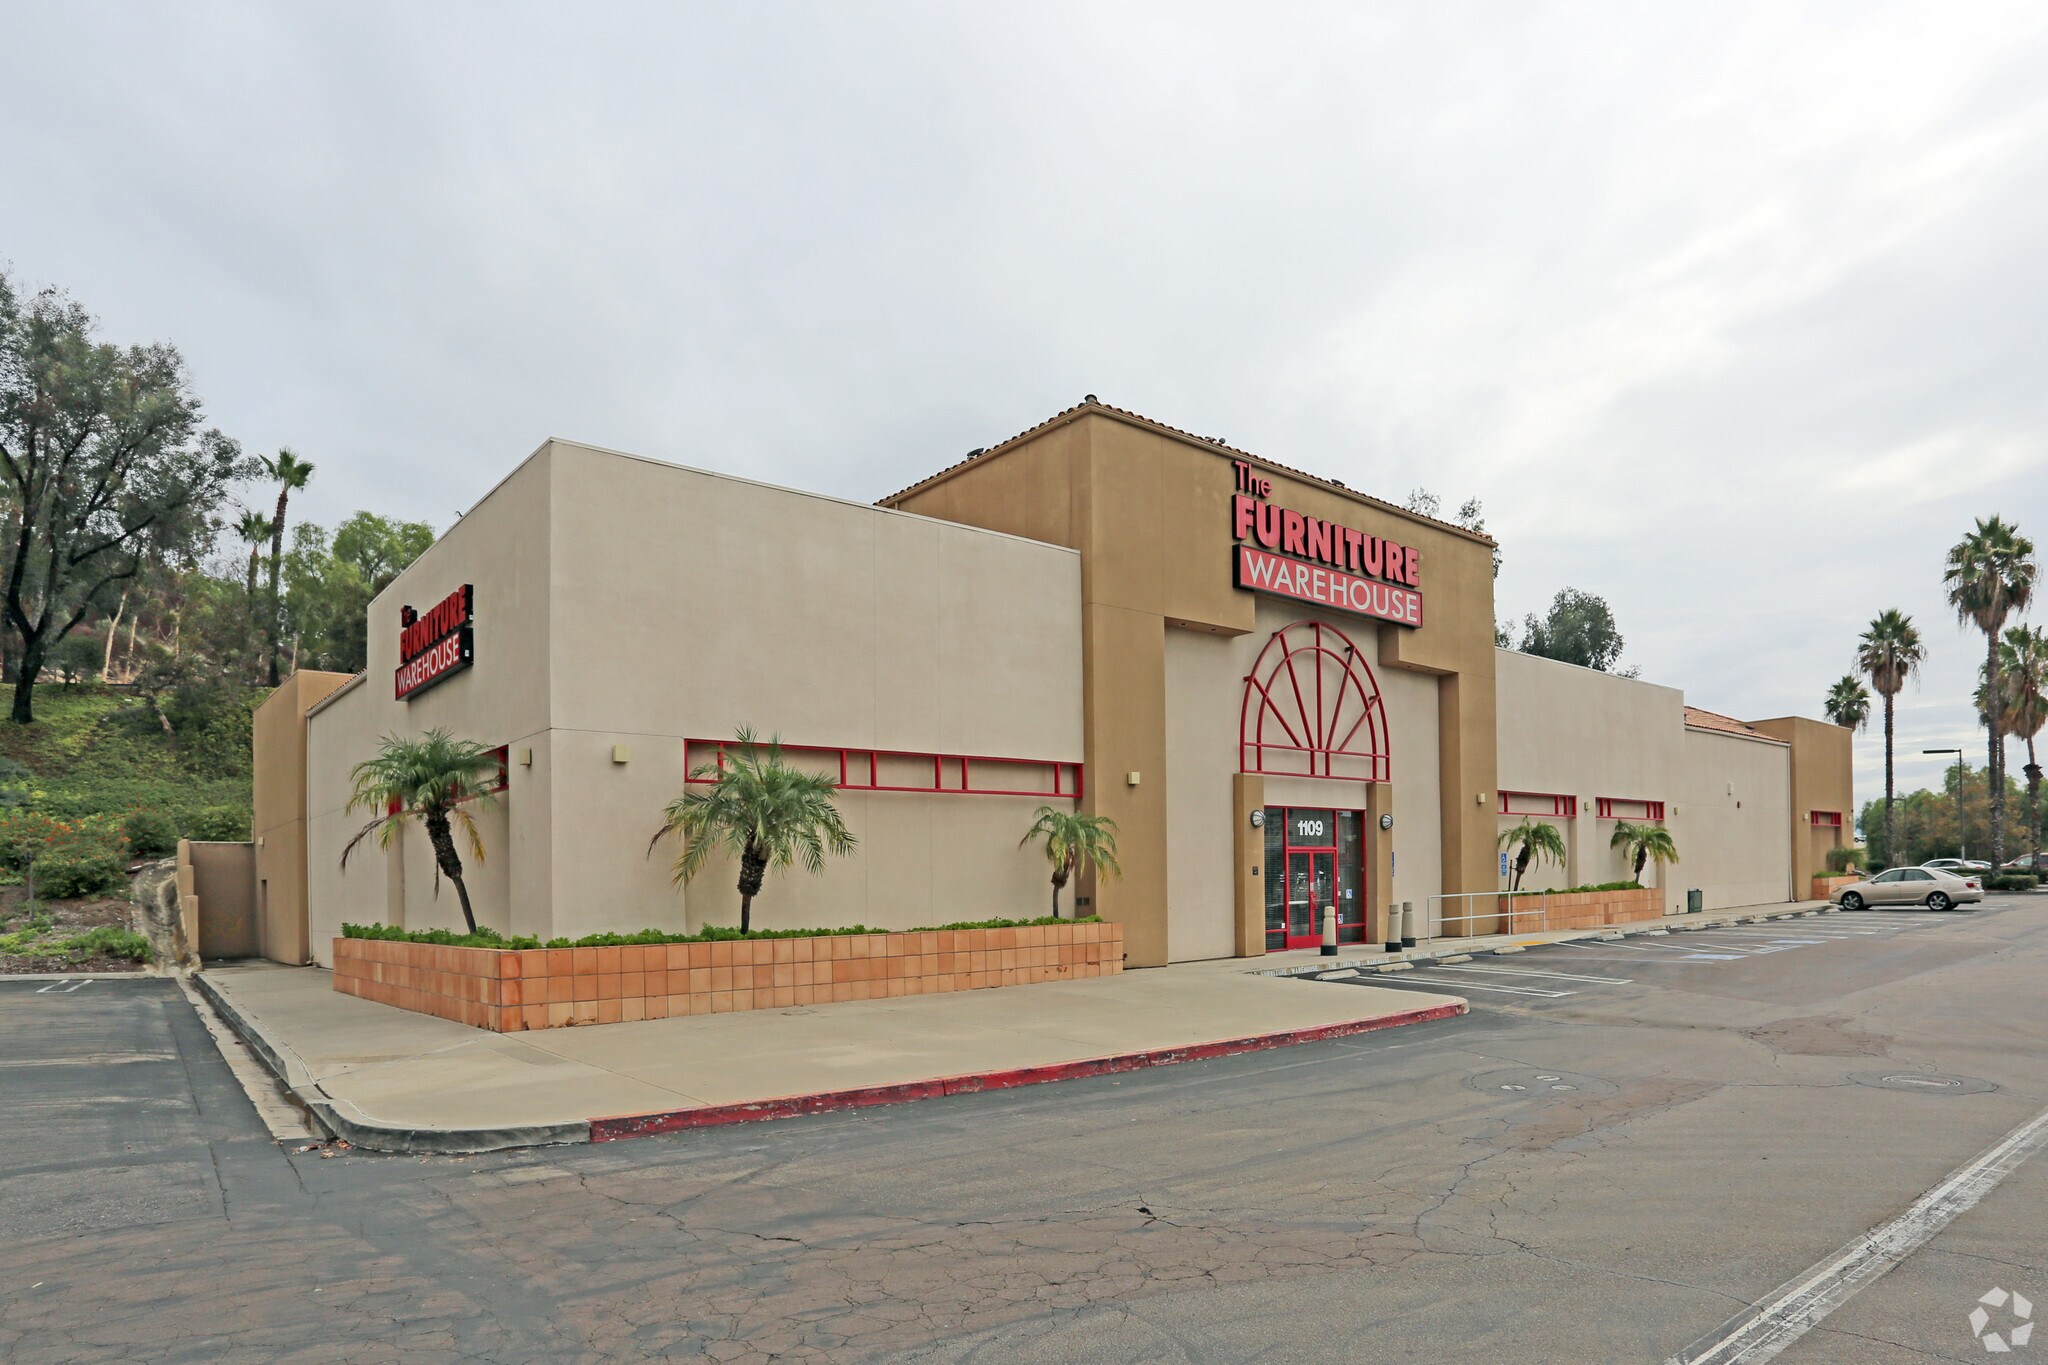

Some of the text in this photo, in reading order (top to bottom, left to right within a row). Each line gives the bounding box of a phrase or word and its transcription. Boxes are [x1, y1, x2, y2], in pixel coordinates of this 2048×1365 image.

[1234, 460, 1272, 498] The
[1235, 494, 1420, 587] FURNITURE
[1245, 550, 1418, 622] WAREHOUSE
[400, 584, 467, 664] FURNITURE
[396, 633, 459, 693] WAREHOUSE
[1297, 820, 1324, 837] 1109
